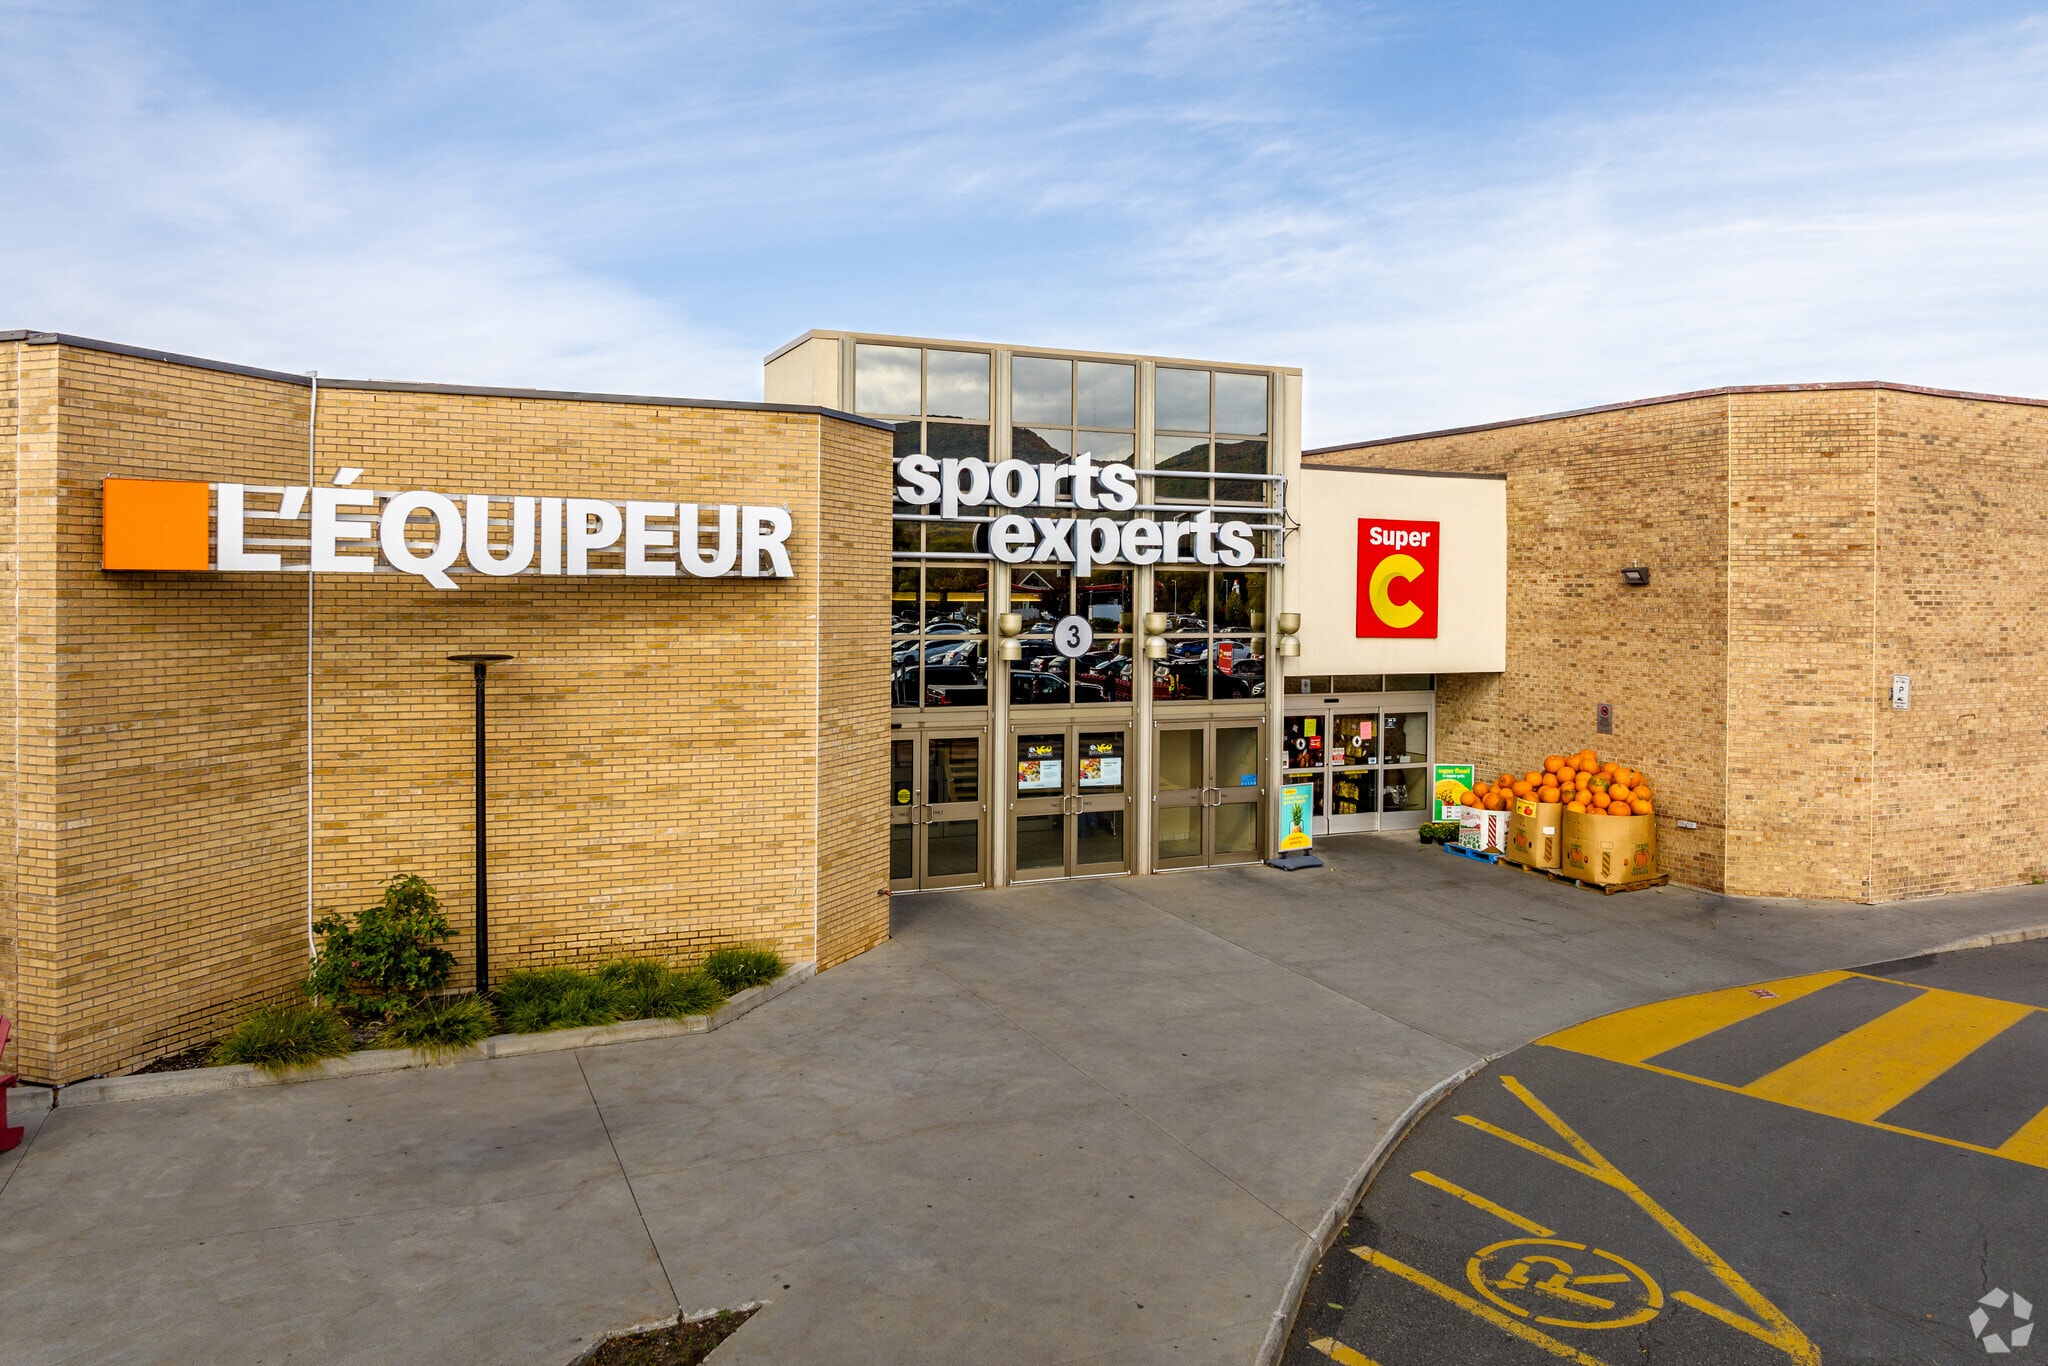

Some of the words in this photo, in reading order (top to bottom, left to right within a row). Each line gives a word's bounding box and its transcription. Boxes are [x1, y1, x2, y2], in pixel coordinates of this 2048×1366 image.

[896, 451, 1138, 519] sports
[216, 466, 795, 590] L'ÉQUIPEUR
[989, 509, 1255, 578] experts
[1369, 526, 1431, 550] Super
[1369, 553, 1425, 629] C
[1066, 624, 1081, 649] 3
